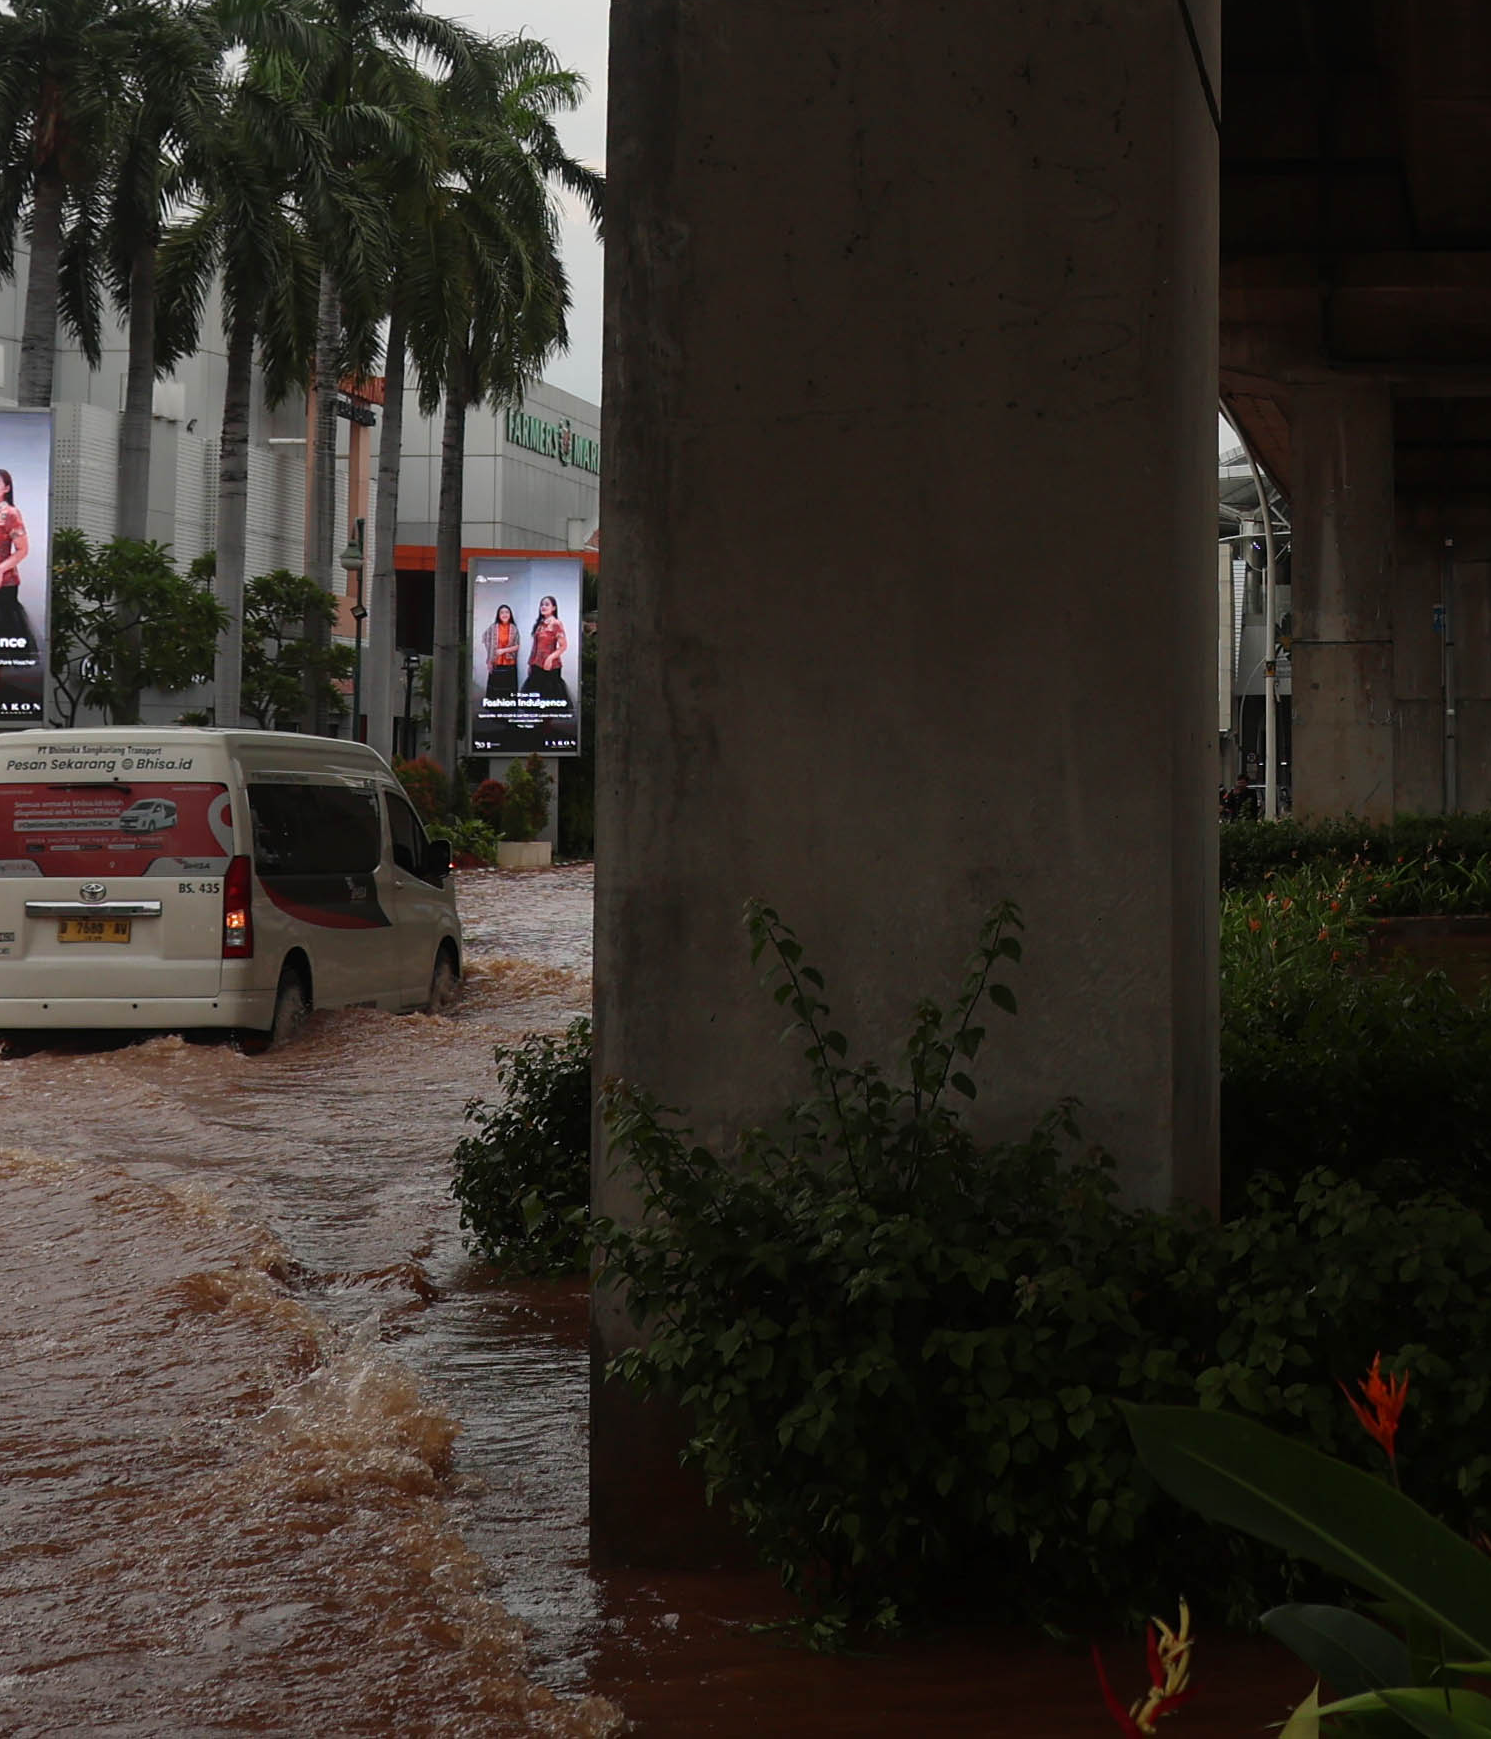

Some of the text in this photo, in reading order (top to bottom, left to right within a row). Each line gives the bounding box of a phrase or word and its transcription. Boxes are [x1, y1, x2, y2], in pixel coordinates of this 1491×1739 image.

[506, 407, 561, 460] FARMERS
[482, 697, 568, 709] Fashion Indulgence
[127, 746, 162, 757] Transport
[6, 758, 193, 773] Pesan Sekarang Bhisa.id
[178, 882, 220, 894] BS. 435
